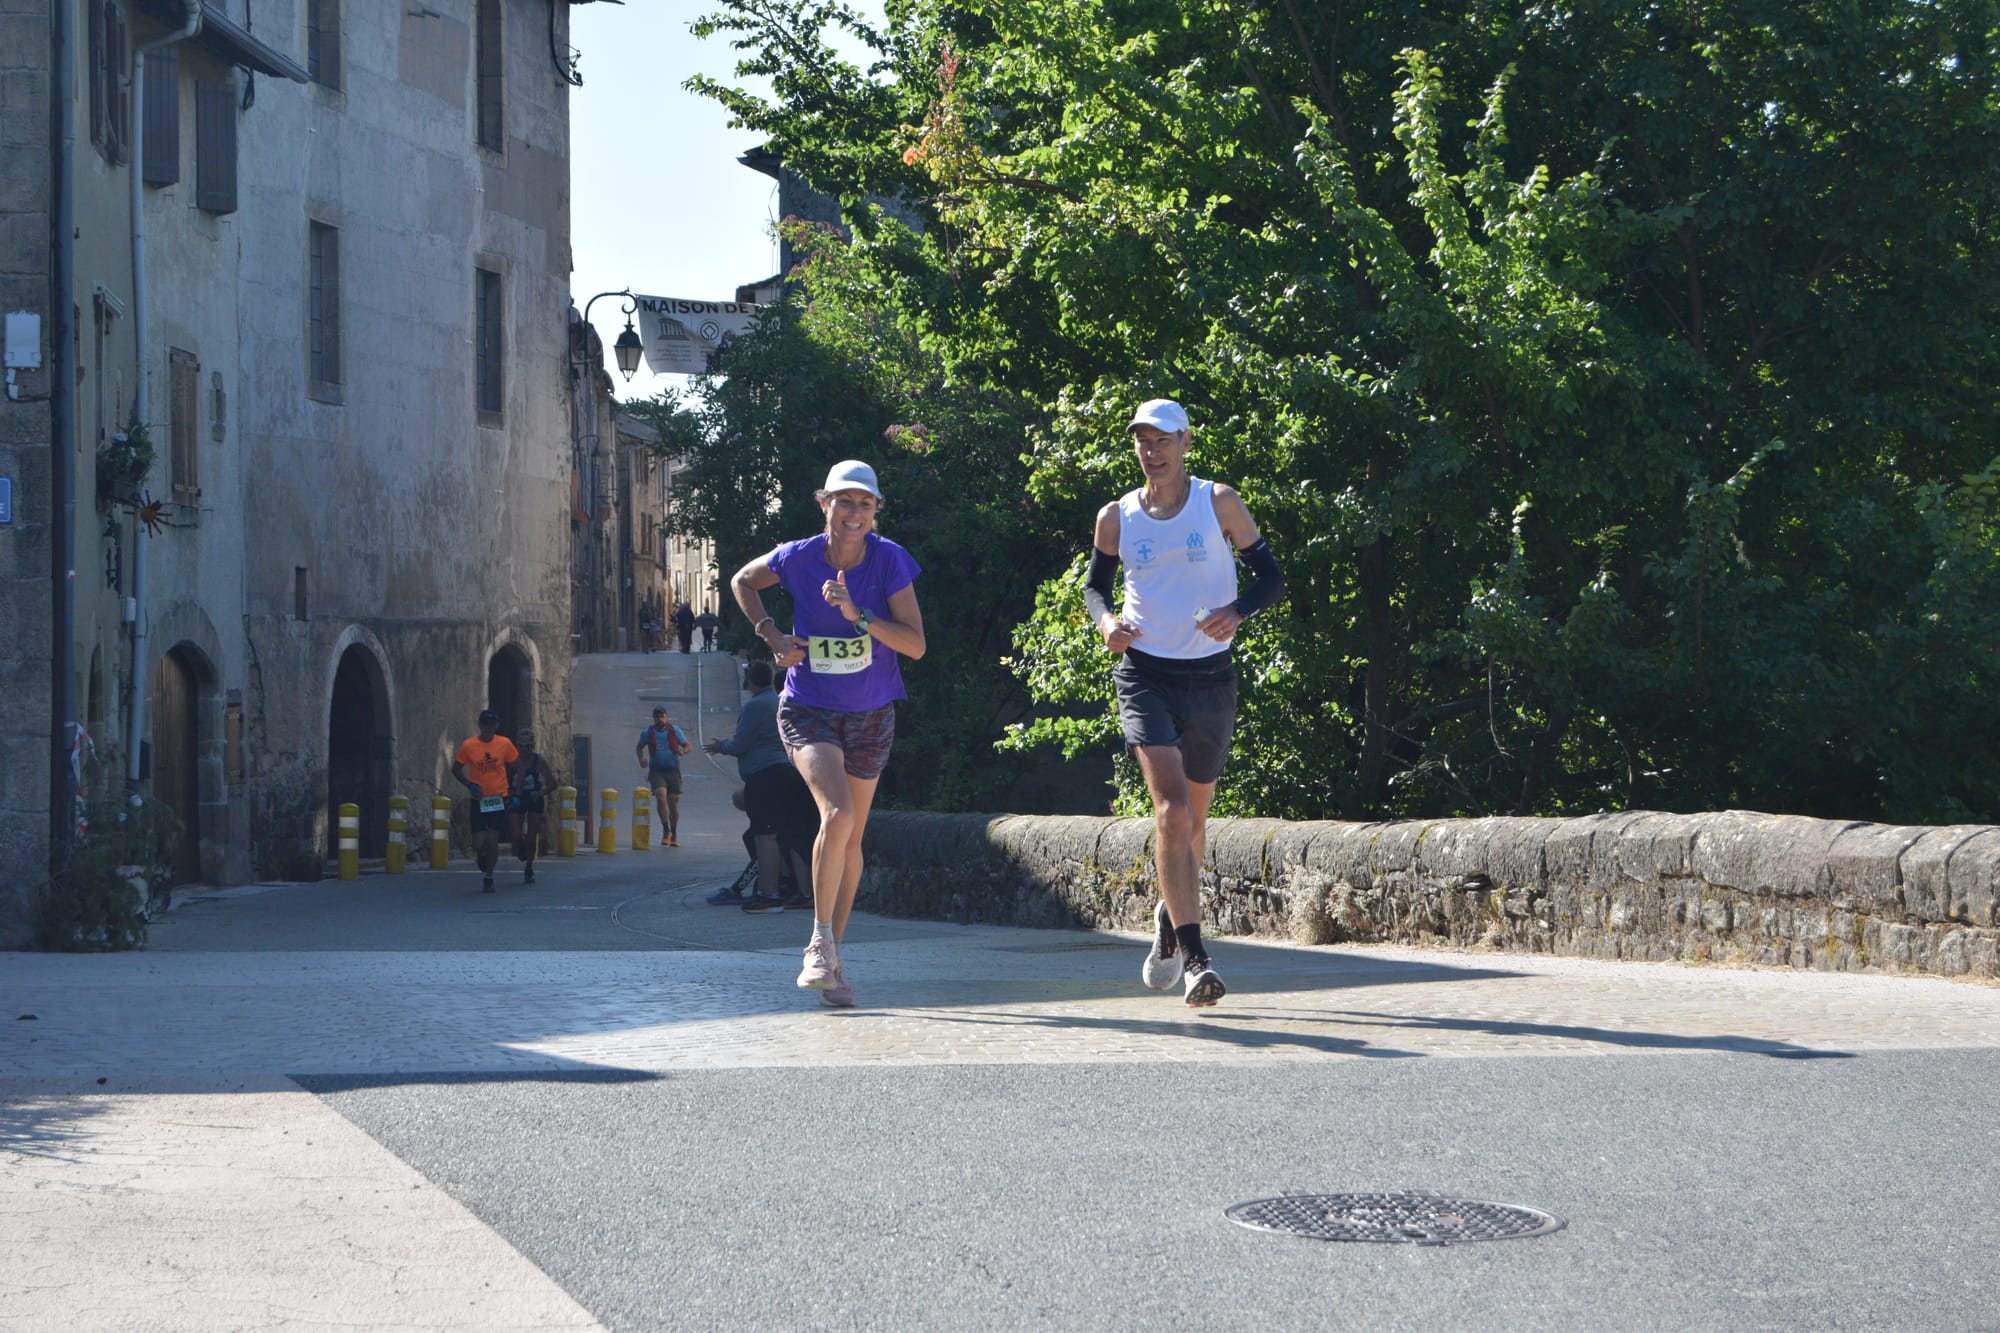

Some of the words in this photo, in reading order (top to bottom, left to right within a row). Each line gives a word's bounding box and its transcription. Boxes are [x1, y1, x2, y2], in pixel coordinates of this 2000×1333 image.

[642, 299, 719, 314] MAISON
[725, 303, 749, 314] DE
[818, 639, 865, 659] 133
